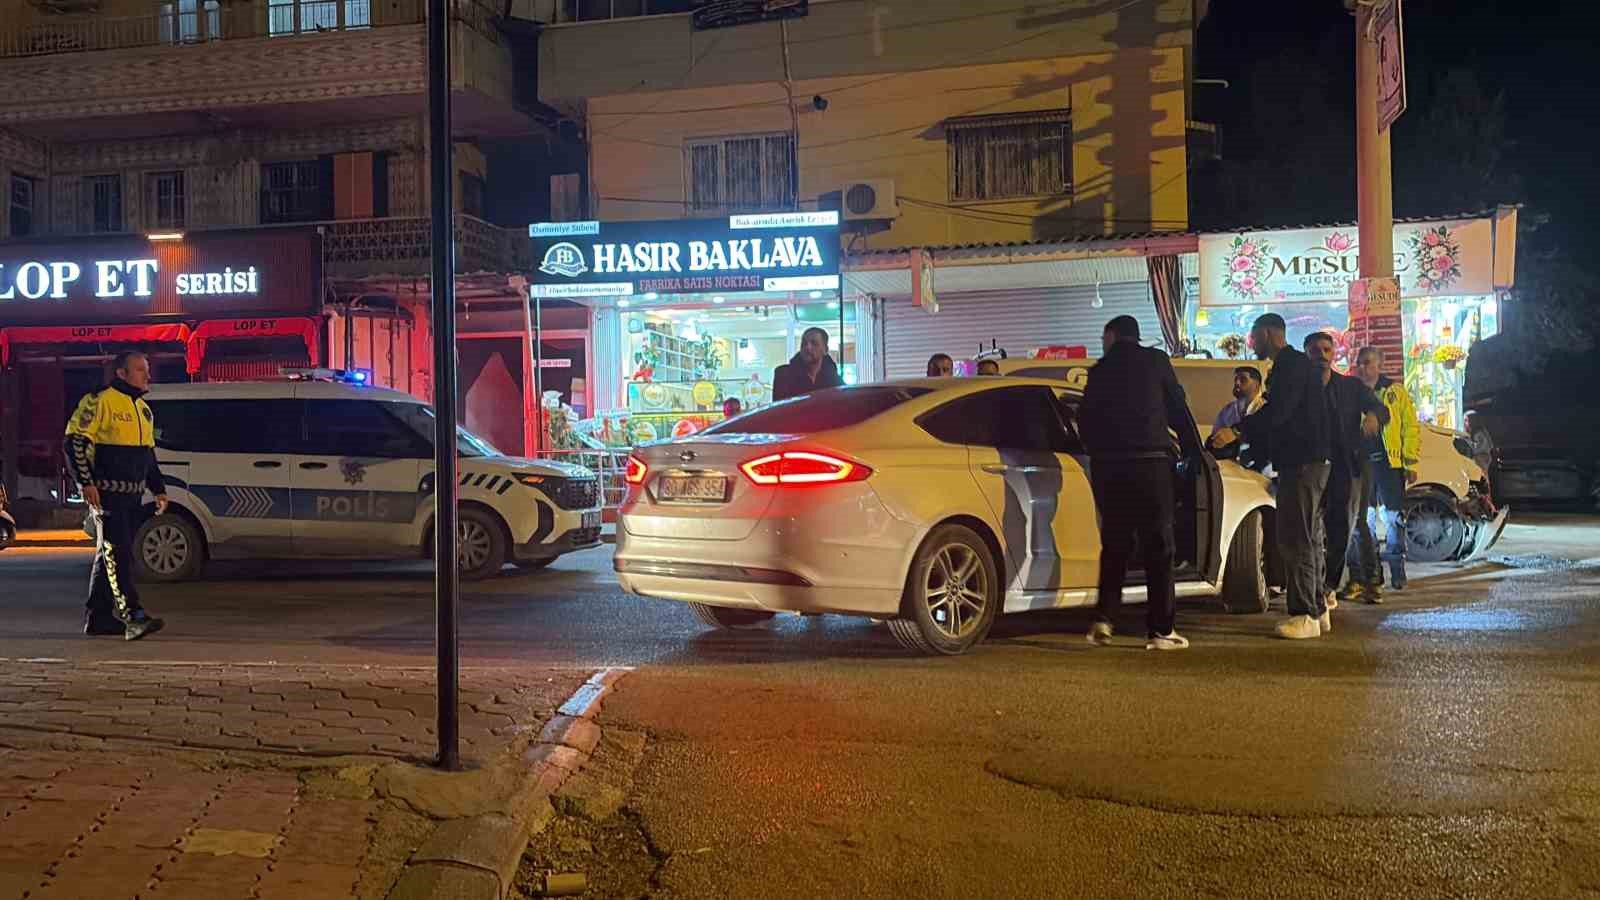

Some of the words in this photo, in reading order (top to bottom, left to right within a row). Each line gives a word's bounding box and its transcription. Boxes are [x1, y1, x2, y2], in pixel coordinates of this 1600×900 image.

[593, 241, 683, 273] HASIR
[689, 236, 823, 270] BAKLAVA
[1264, 252, 1410, 281] MESUE
[95, 259, 158, 297] ET
[176, 265, 258, 295] SERİSİ
[71, 328, 96, 337] LOP
[98, 328, 113, 337] ET
[316, 491, 390, 518] POLİS
